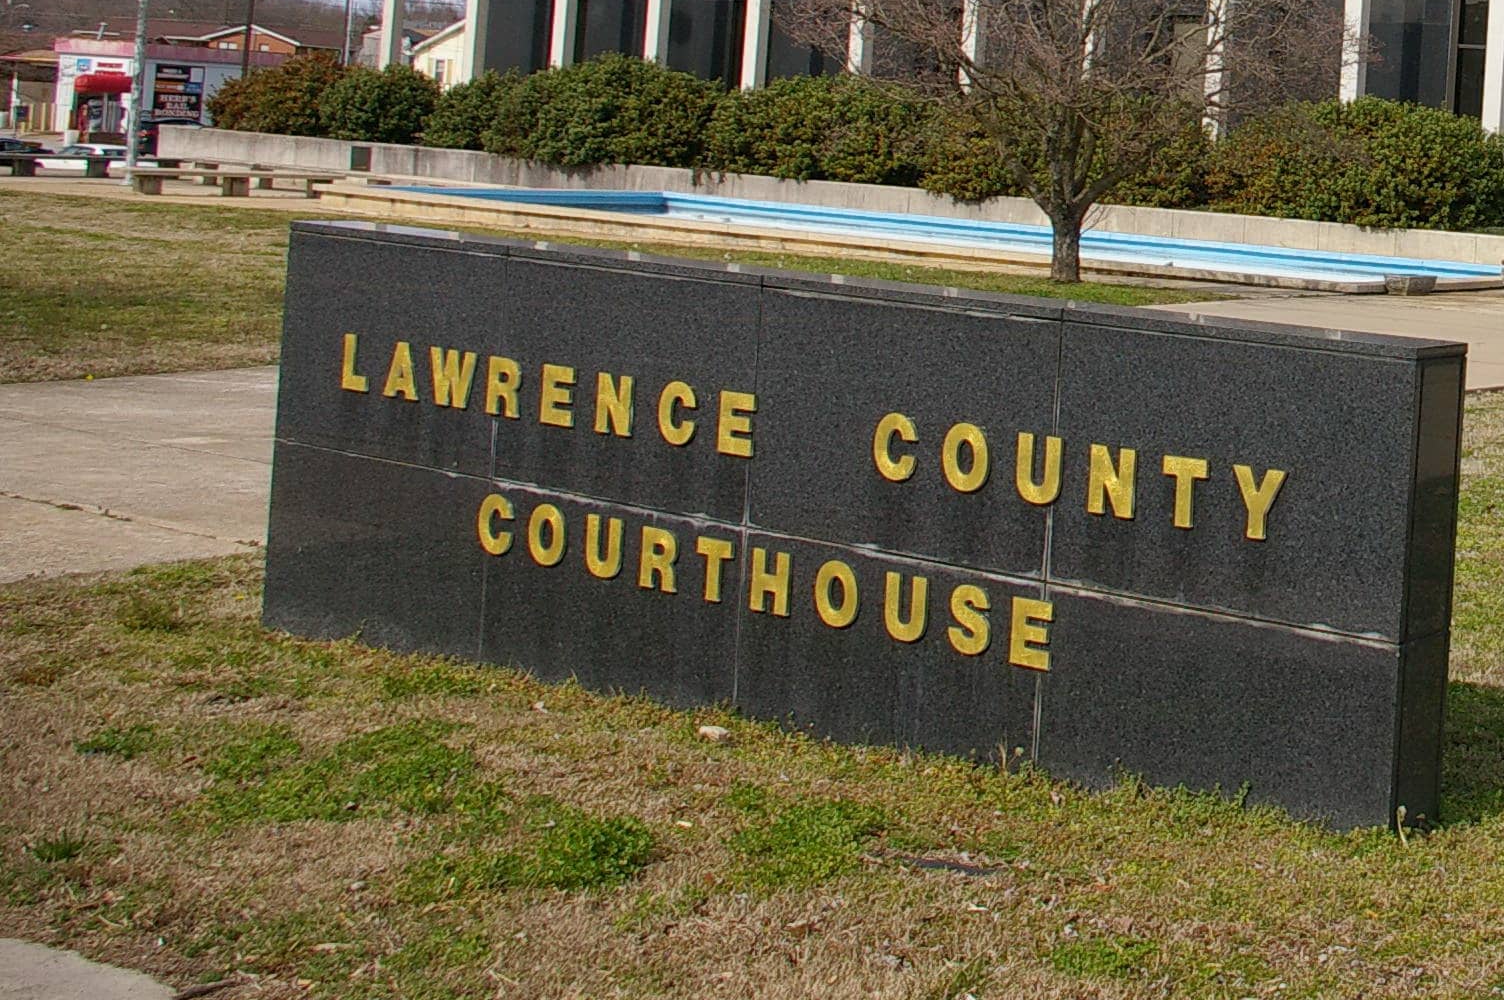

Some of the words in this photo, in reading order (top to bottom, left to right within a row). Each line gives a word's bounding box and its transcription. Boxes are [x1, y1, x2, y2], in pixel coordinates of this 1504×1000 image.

[340, 334, 756, 458] LAWRENCE
[873, 412, 1287, 541] COUNTY
[476, 493, 1054, 671] COURTHOUSE
